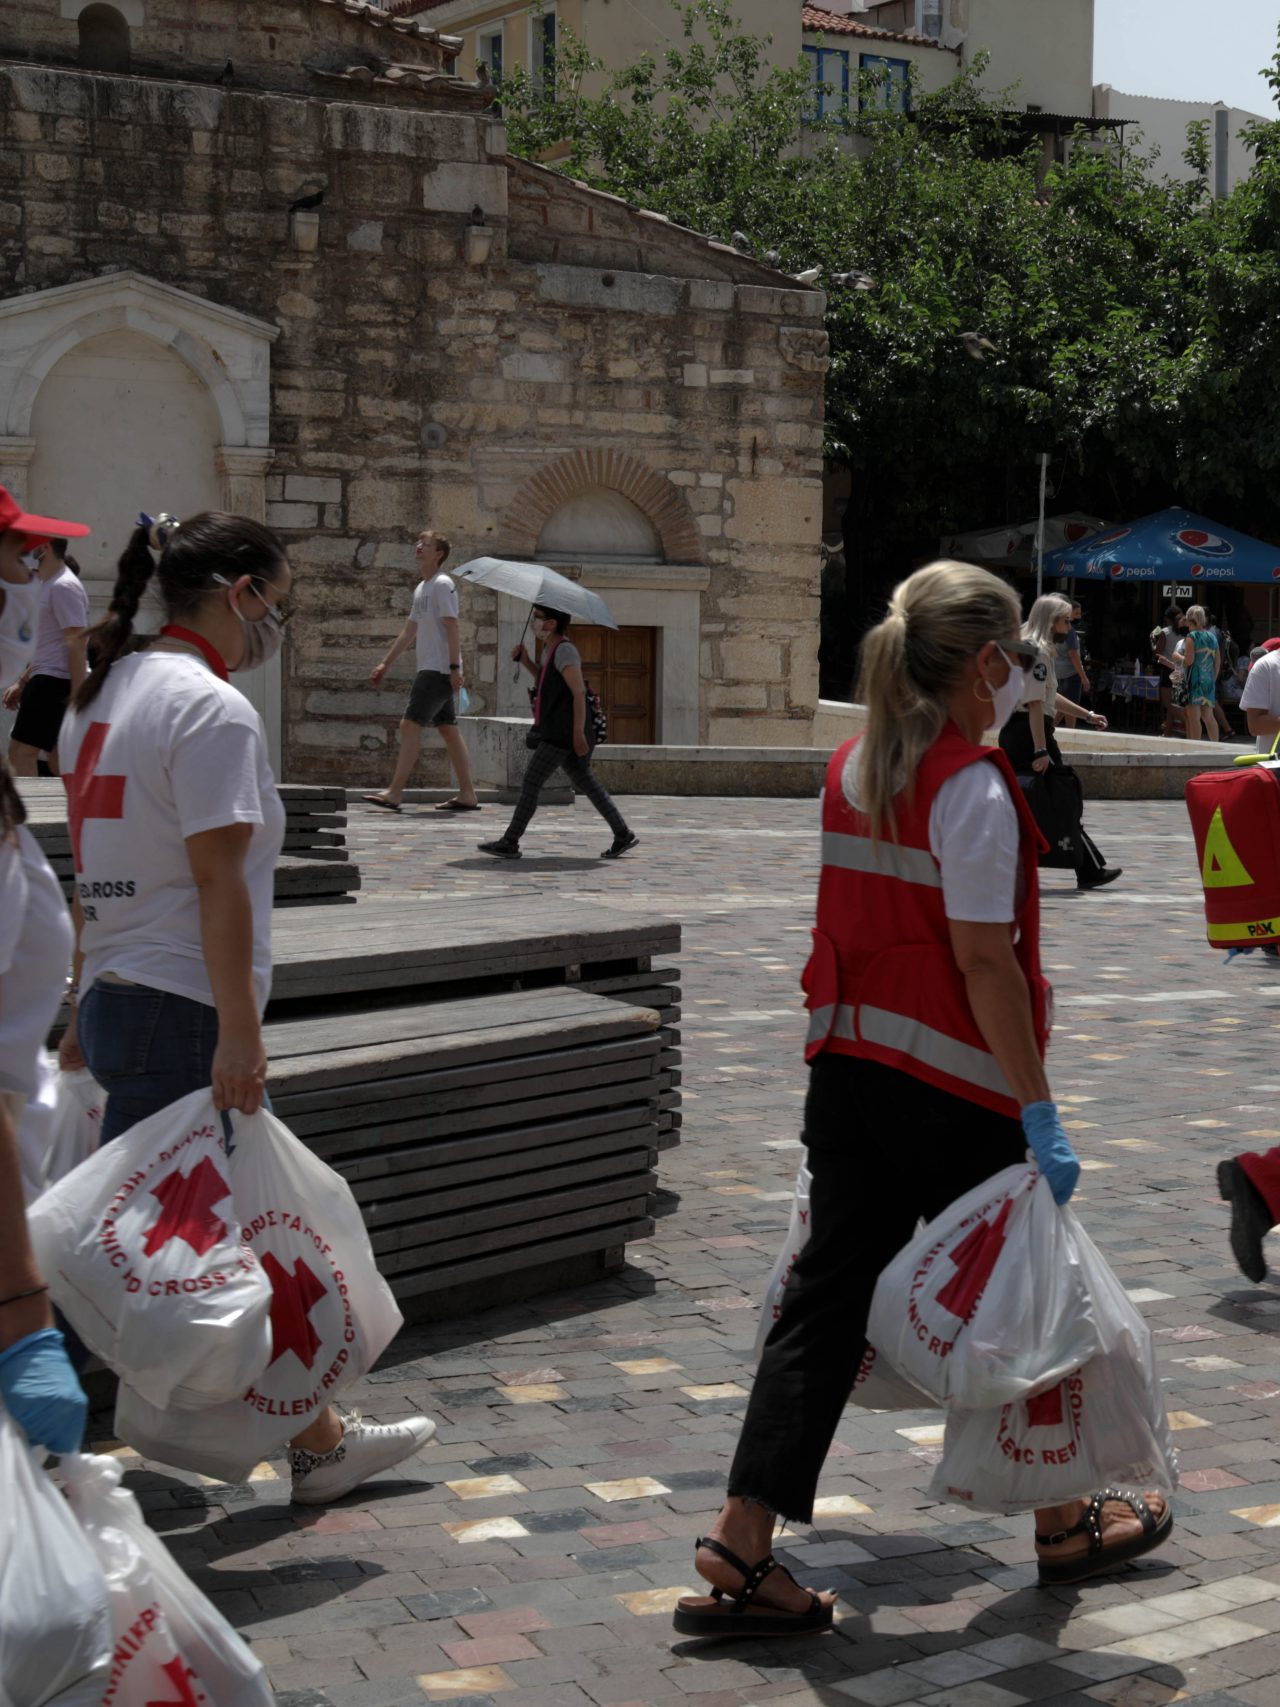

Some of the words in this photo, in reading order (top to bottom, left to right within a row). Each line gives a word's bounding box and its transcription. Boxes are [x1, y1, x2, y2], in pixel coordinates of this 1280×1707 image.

[1126, 566, 1155, 577] pepsi
[1206, 566, 1235, 577] pepsi
[1165, 587, 1190, 597] ATM
[91, 880, 136, 899] ROSS
[148, 1271, 228, 1297] CROSS
[321, 1348, 350, 1391] RED
